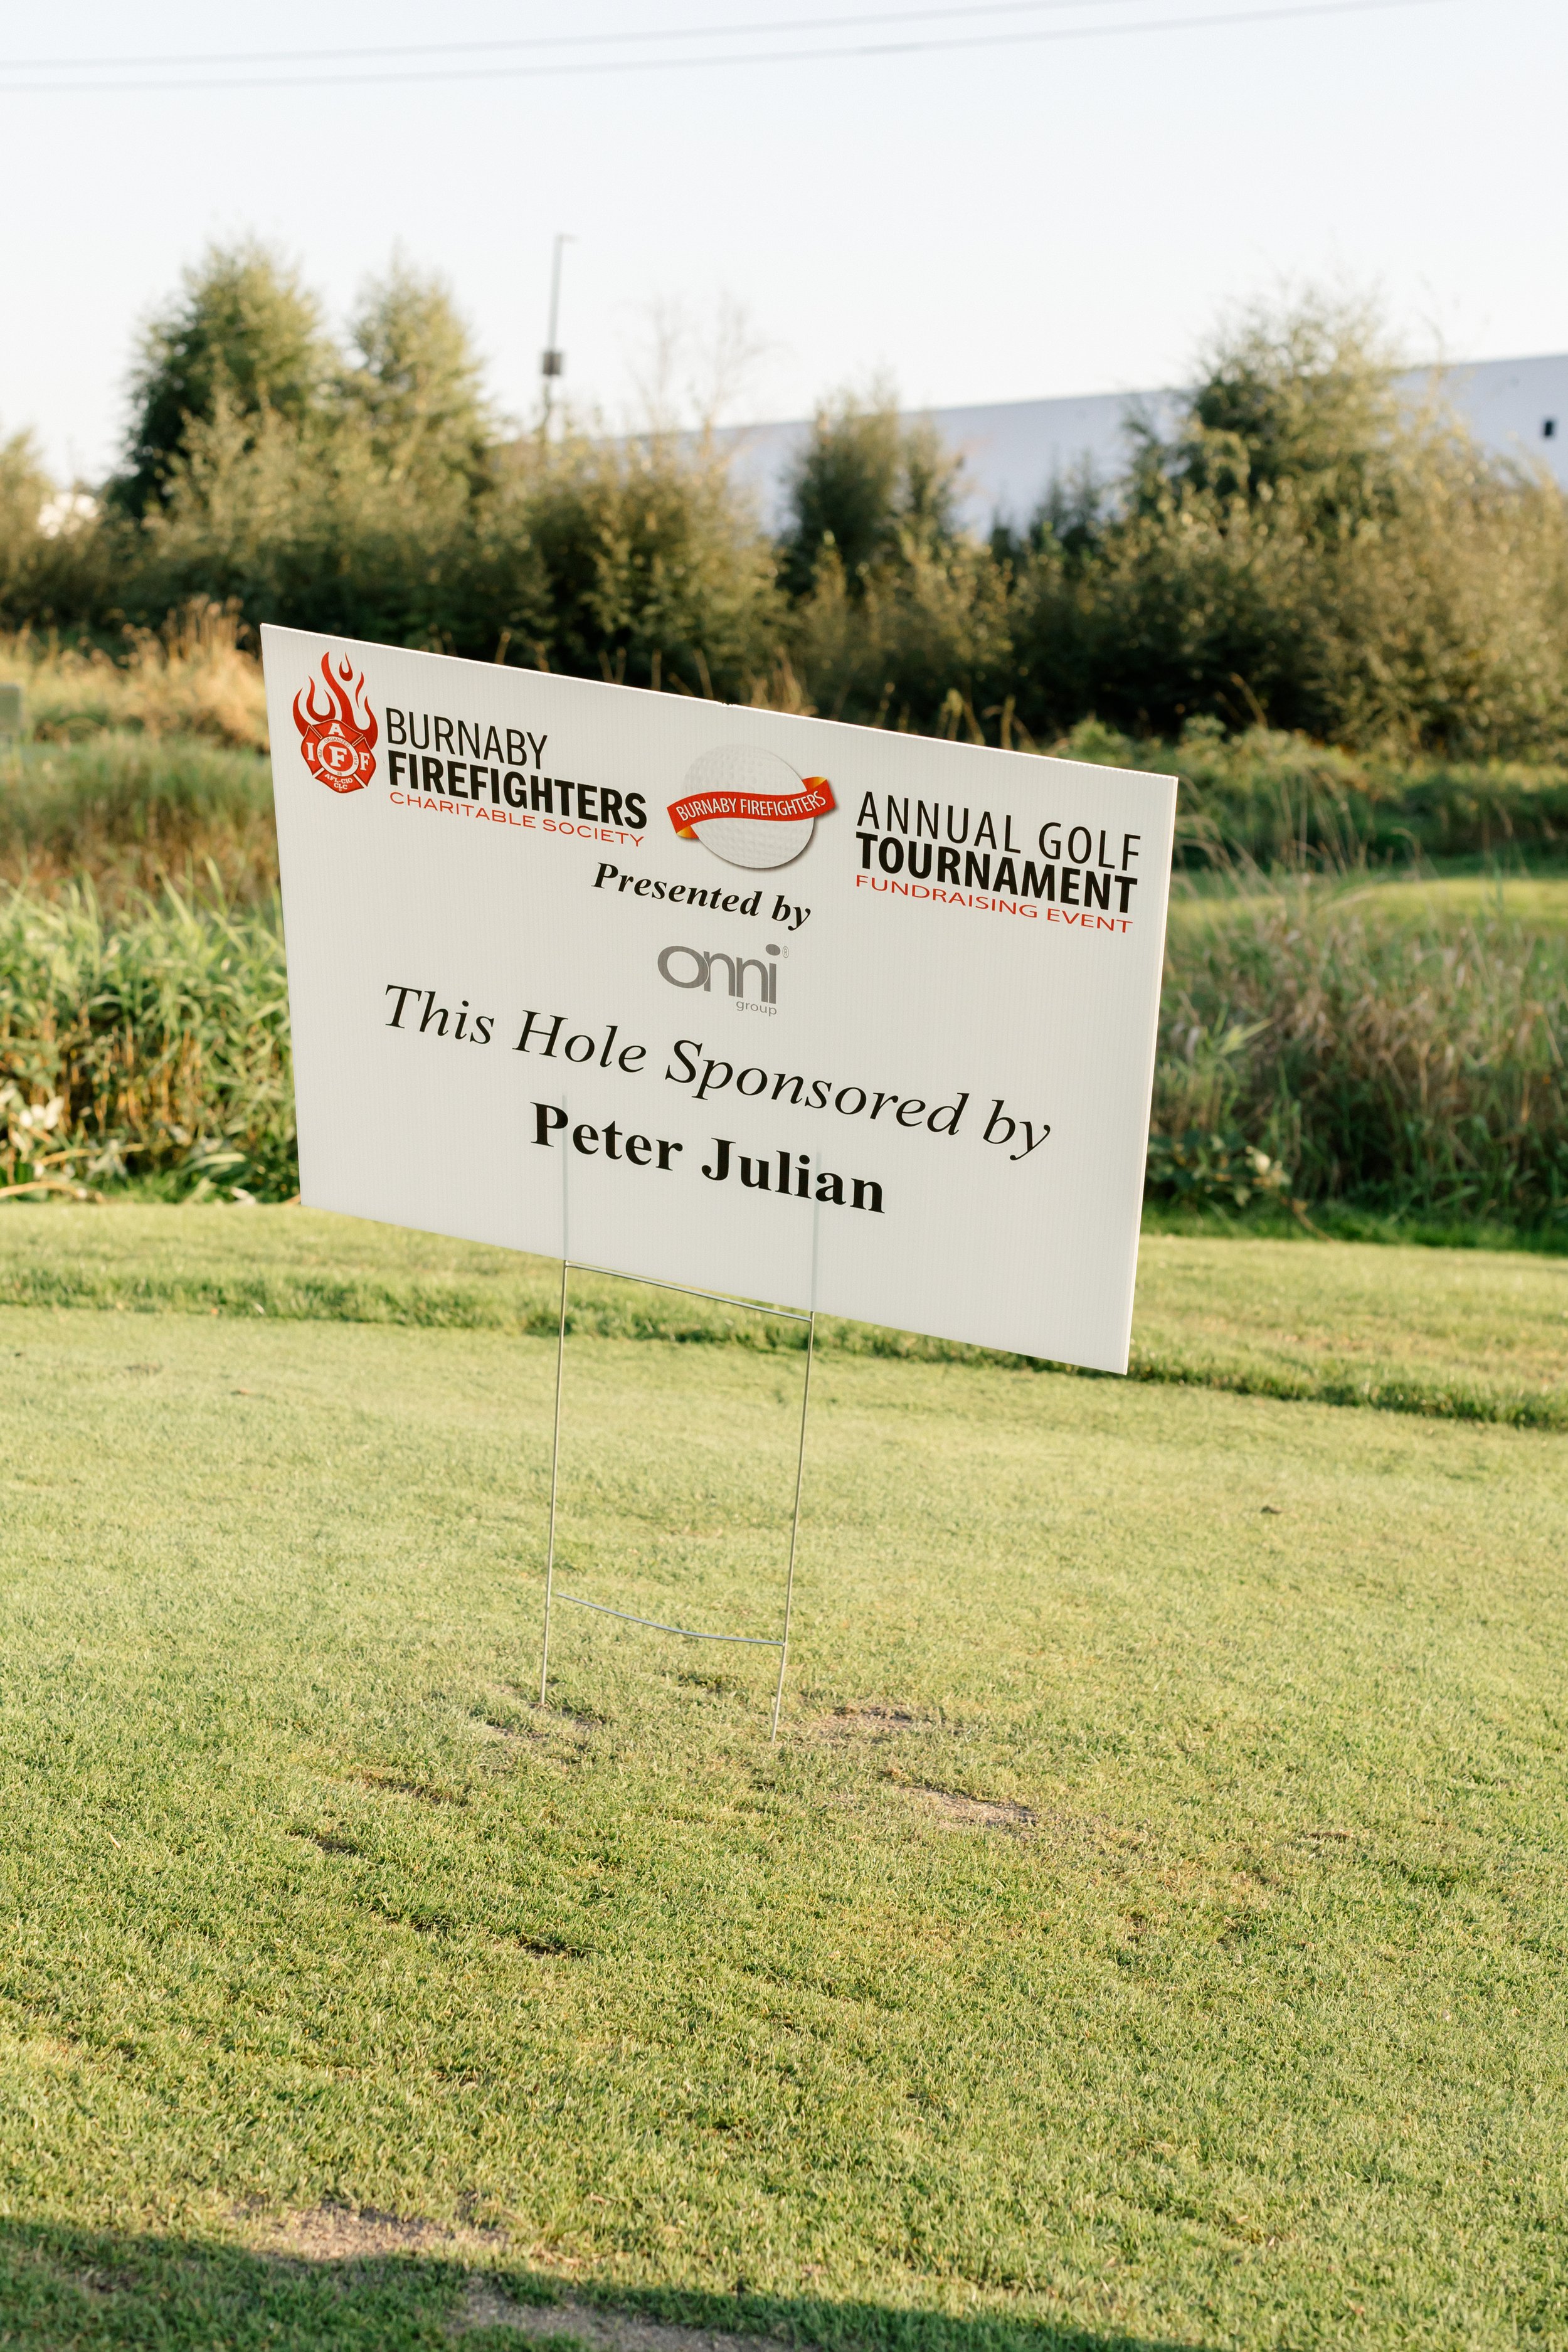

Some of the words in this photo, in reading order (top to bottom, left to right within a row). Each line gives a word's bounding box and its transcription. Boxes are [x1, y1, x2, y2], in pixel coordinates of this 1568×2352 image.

[324, 738, 350, 748] ORGANIZED
[386, 707, 548, 770] BURNABY
[324, 773, 353, 784] AFL-CIO
[388, 750, 647, 829] FIREFIGHTERS
[675, 798, 736, 821] BURNABY
[740, 790, 826, 817] FIREFIGHTERS
[390, 792, 536, 828] CHARITABLE
[543, 819, 644, 847] SOCIETY
[857, 791, 1021, 854] ANNUAL
[1039, 822, 1141, 871] GOLF
[591, 862, 763, 916] Presented
[771, 895, 811, 931] by
[856, 832, 1138, 914] TOURNAMENT
[856, 875, 1037, 918] FUNDRAISING
[1047, 908, 1133, 933] EVENT
[657, 944, 781, 1004] onni
[736, 1000, 777, 1017] group
[385, 984, 495, 1044] This
[512, 1009, 647, 1073] Hole
[664, 1039, 970, 1135] Sponsored
[982, 1099, 1051, 1161] by
[529, 1101, 683, 1171] Peter
[701, 1137, 885, 1214] Julian
